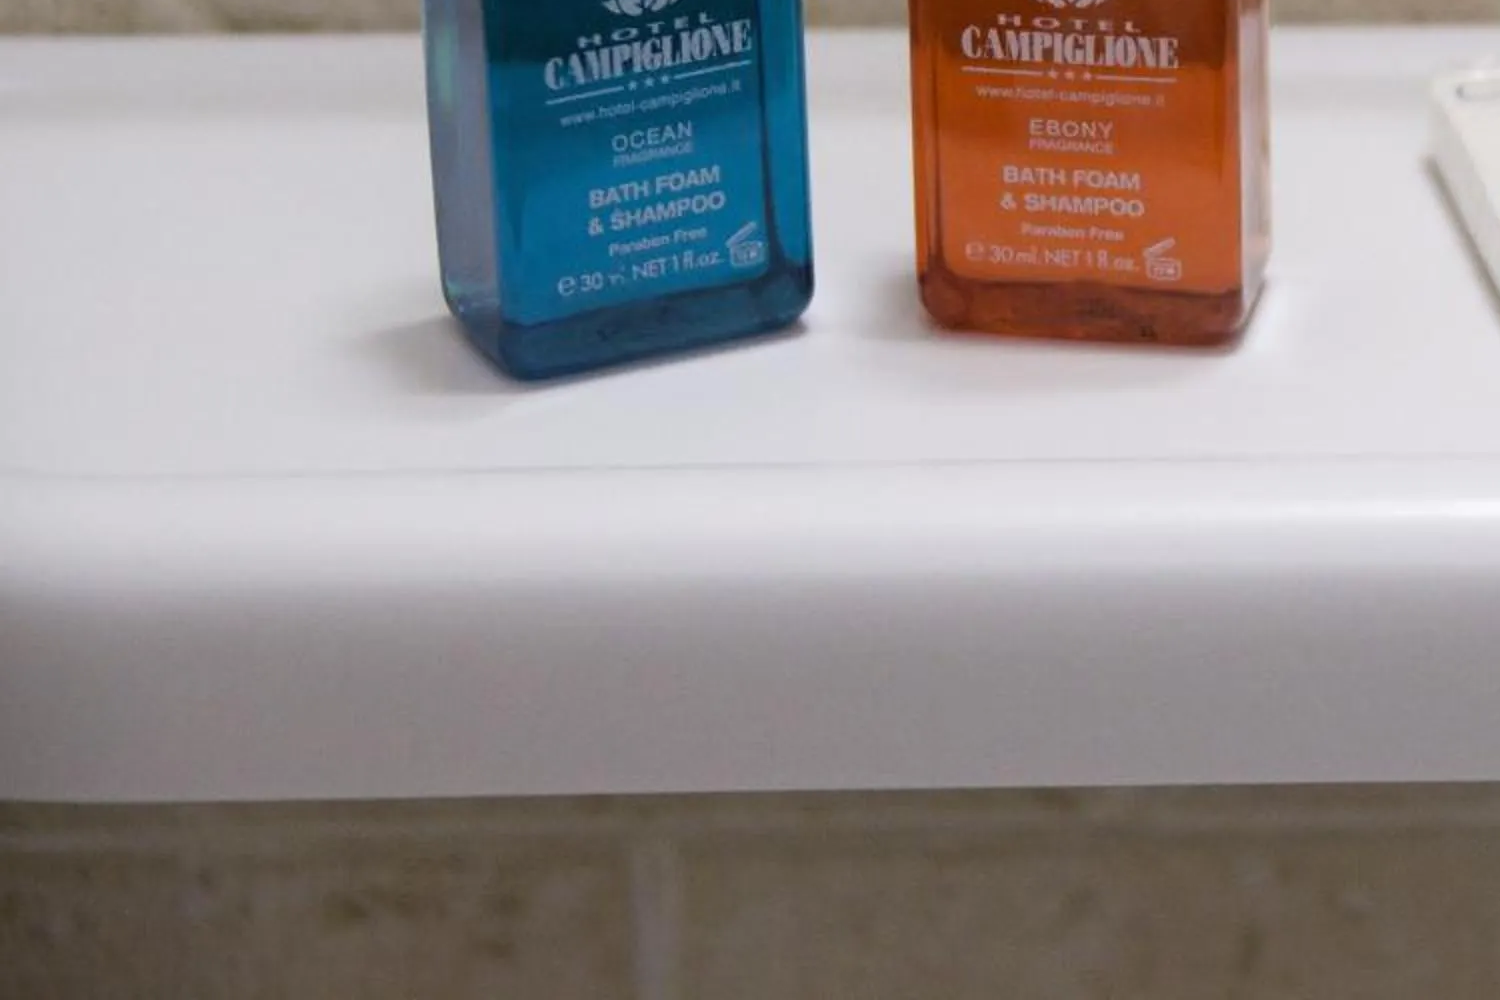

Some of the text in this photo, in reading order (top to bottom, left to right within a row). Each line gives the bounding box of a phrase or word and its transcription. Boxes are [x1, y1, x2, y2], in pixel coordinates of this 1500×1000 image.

[577, 11, 714, 48] HOTEL
[997, 13, 1141, 33] HOTEL
[544, 19, 752, 90] CAMPIGLIONE
[961, 24, 1179, 69] CAMPIGLIONE
[559, 79, 742, 127] www.hotel-campiglione.it
[976, 84, 1166, 108] www.hotel-campiglione.it
[611, 120, 693, 152] OCEAN
[1029, 118, 1114, 139] EBONY
[613, 141, 694, 168] FRAGRANCE
[1029, 138, 1114, 155] FRAGRANCE
[588, 165, 721, 209] BATH FOAM
[1003, 165, 1141, 190] BATH FOAM
[588, 190, 726, 236] & SHAMPOO
[1000, 192, 1145, 217] & SHAMPOO
[609, 227, 708, 256] Paraben Free
[1021, 222, 1124, 242] Paraben Free
[989, 245, 1013, 263] 30
[1045, 249, 1080, 268] NET
[580, 272, 604, 292] 30
[633, 257, 666, 280] NET
